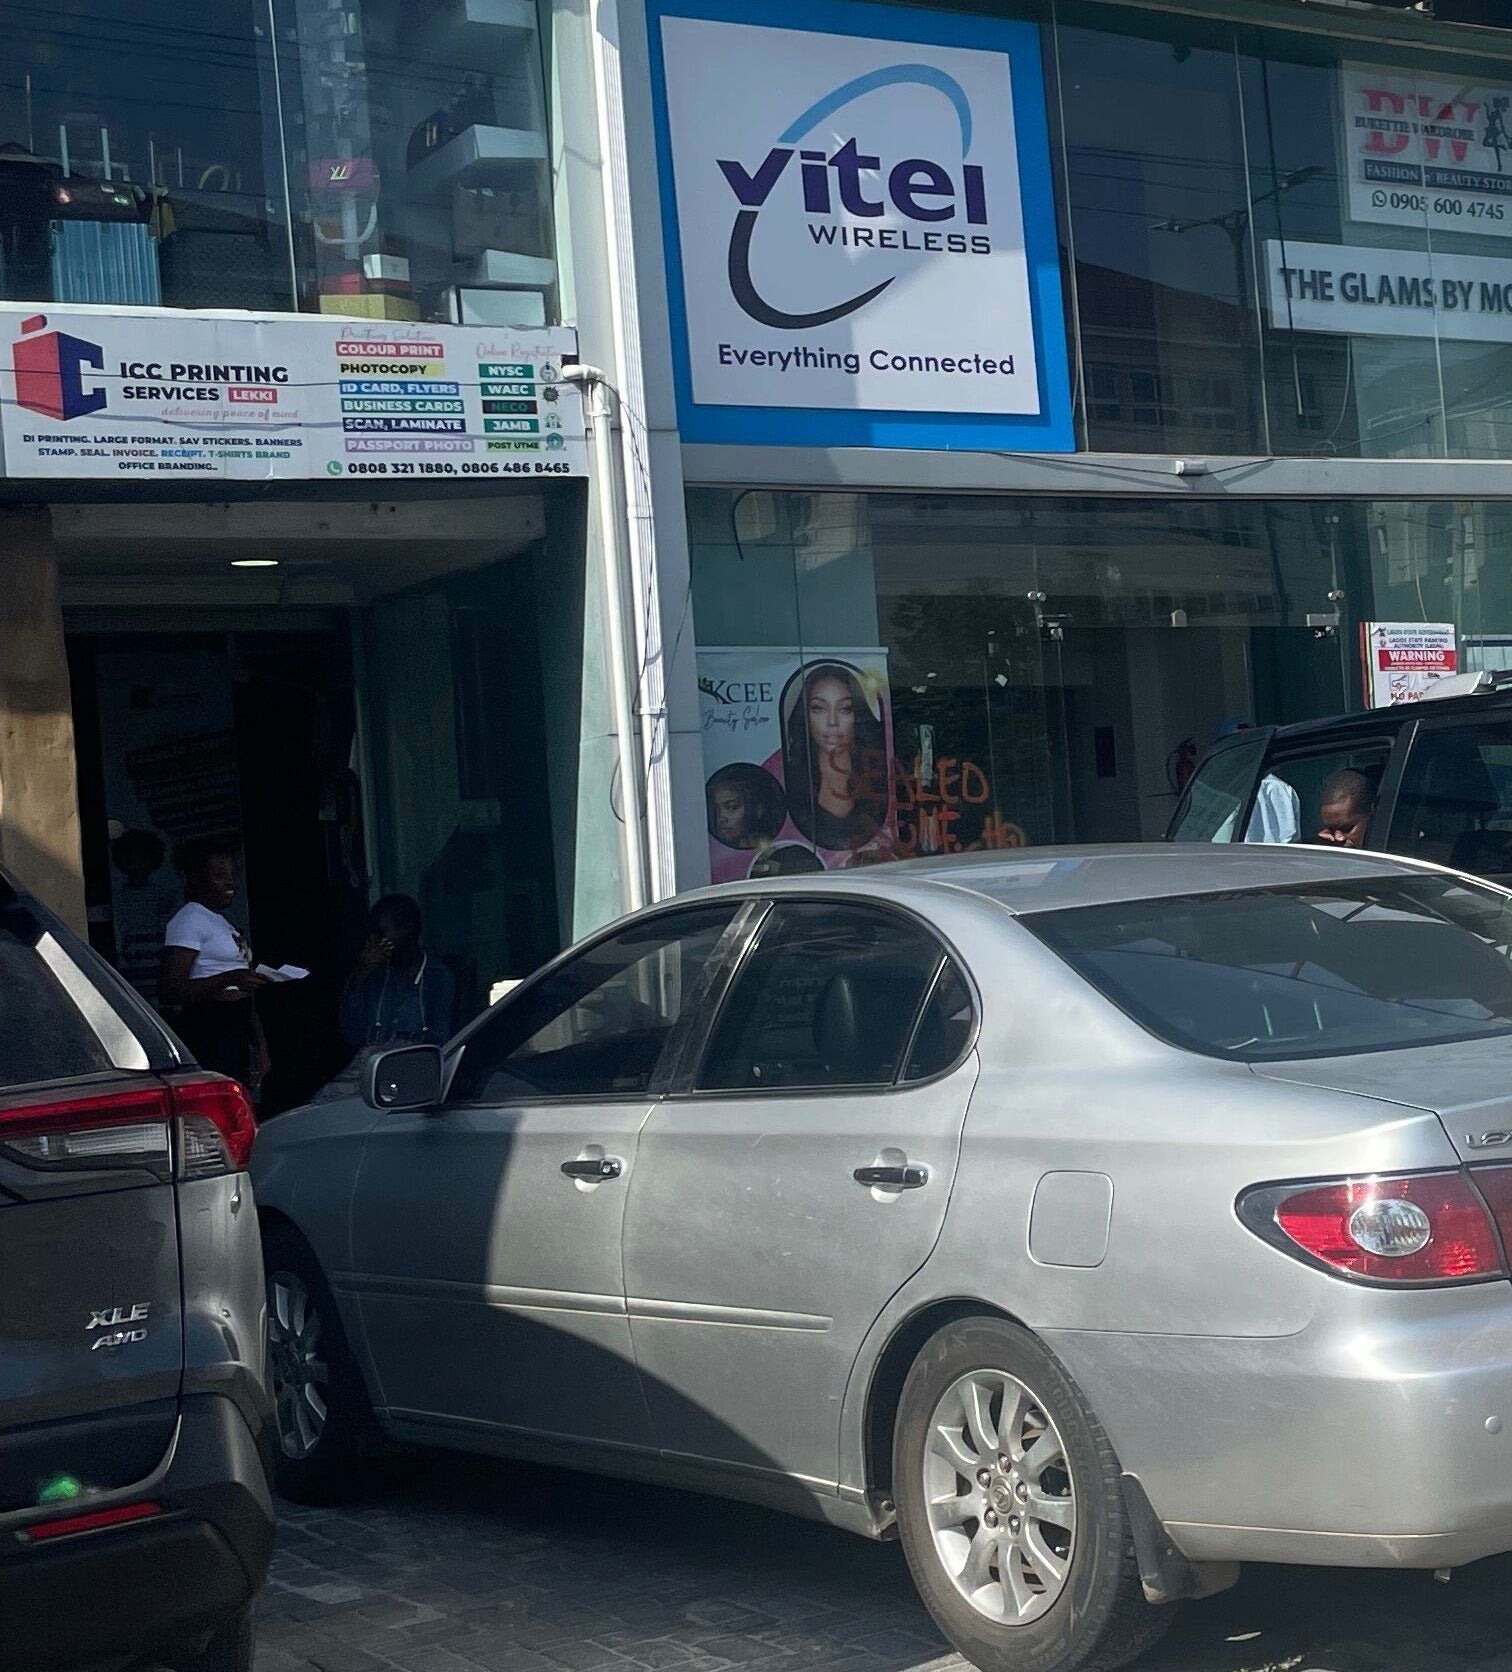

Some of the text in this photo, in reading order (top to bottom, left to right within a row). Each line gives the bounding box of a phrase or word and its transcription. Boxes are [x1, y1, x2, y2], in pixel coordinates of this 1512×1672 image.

[1367, 165, 1419, 181] FASHION
[1436, 172, 1482, 188] BEAUTY
[1434, 197, 1462, 215] 600
[1466, 201, 1504, 220] 4745
[808, 223, 991, 255] WIRELESS
[1280, 267, 1334, 301] THE
[1341, 272, 1437, 307] GLAMS
[1442, 280, 1474, 310] BY
[338, 344, 441, 356] COLOUR PRINT
[718, 344, 1015, 375] Everything Connected
[120, 362, 289, 383] ICC PRINTING
[340, 364, 426, 374] PHOTOCOPY
[488, 366, 524, 376] NYSC
[123, 386, 220, 401] SERVICES
[233, 389, 273, 401] LEKKI
[341, 383, 457, 395] ID CARD, FLYERS
[487, 385, 529, 395] WAEC
[343, 401, 462, 412] BUSINESS CARDS
[491, 402, 528, 412] NECO
[257, 408, 270, 421] of
[272, 409, 299, 418] mind
[345, 419, 462, 431] SCAN, LAMINATE
[493, 421, 531, 431] JAMB
[94, 436, 128, 444] LARGE
[256, 438, 303, 447] BANNERS
[347, 439, 472, 451] PASSPORT PHOTO
[208, 450, 253, 458] T-SHIRTS
[255, 451, 290, 459] BRAND
[119, 462, 155, 470] OFFICE
[348, 462, 570, 475] 0808 321 1880, 0806 486 8465
[1389, 650, 1446, 661] WARNING
[707, 679, 774, 704] KCEE
[85, 1301, 152, 1330] XLE
[91, 1328, 149, 1350] AWD
